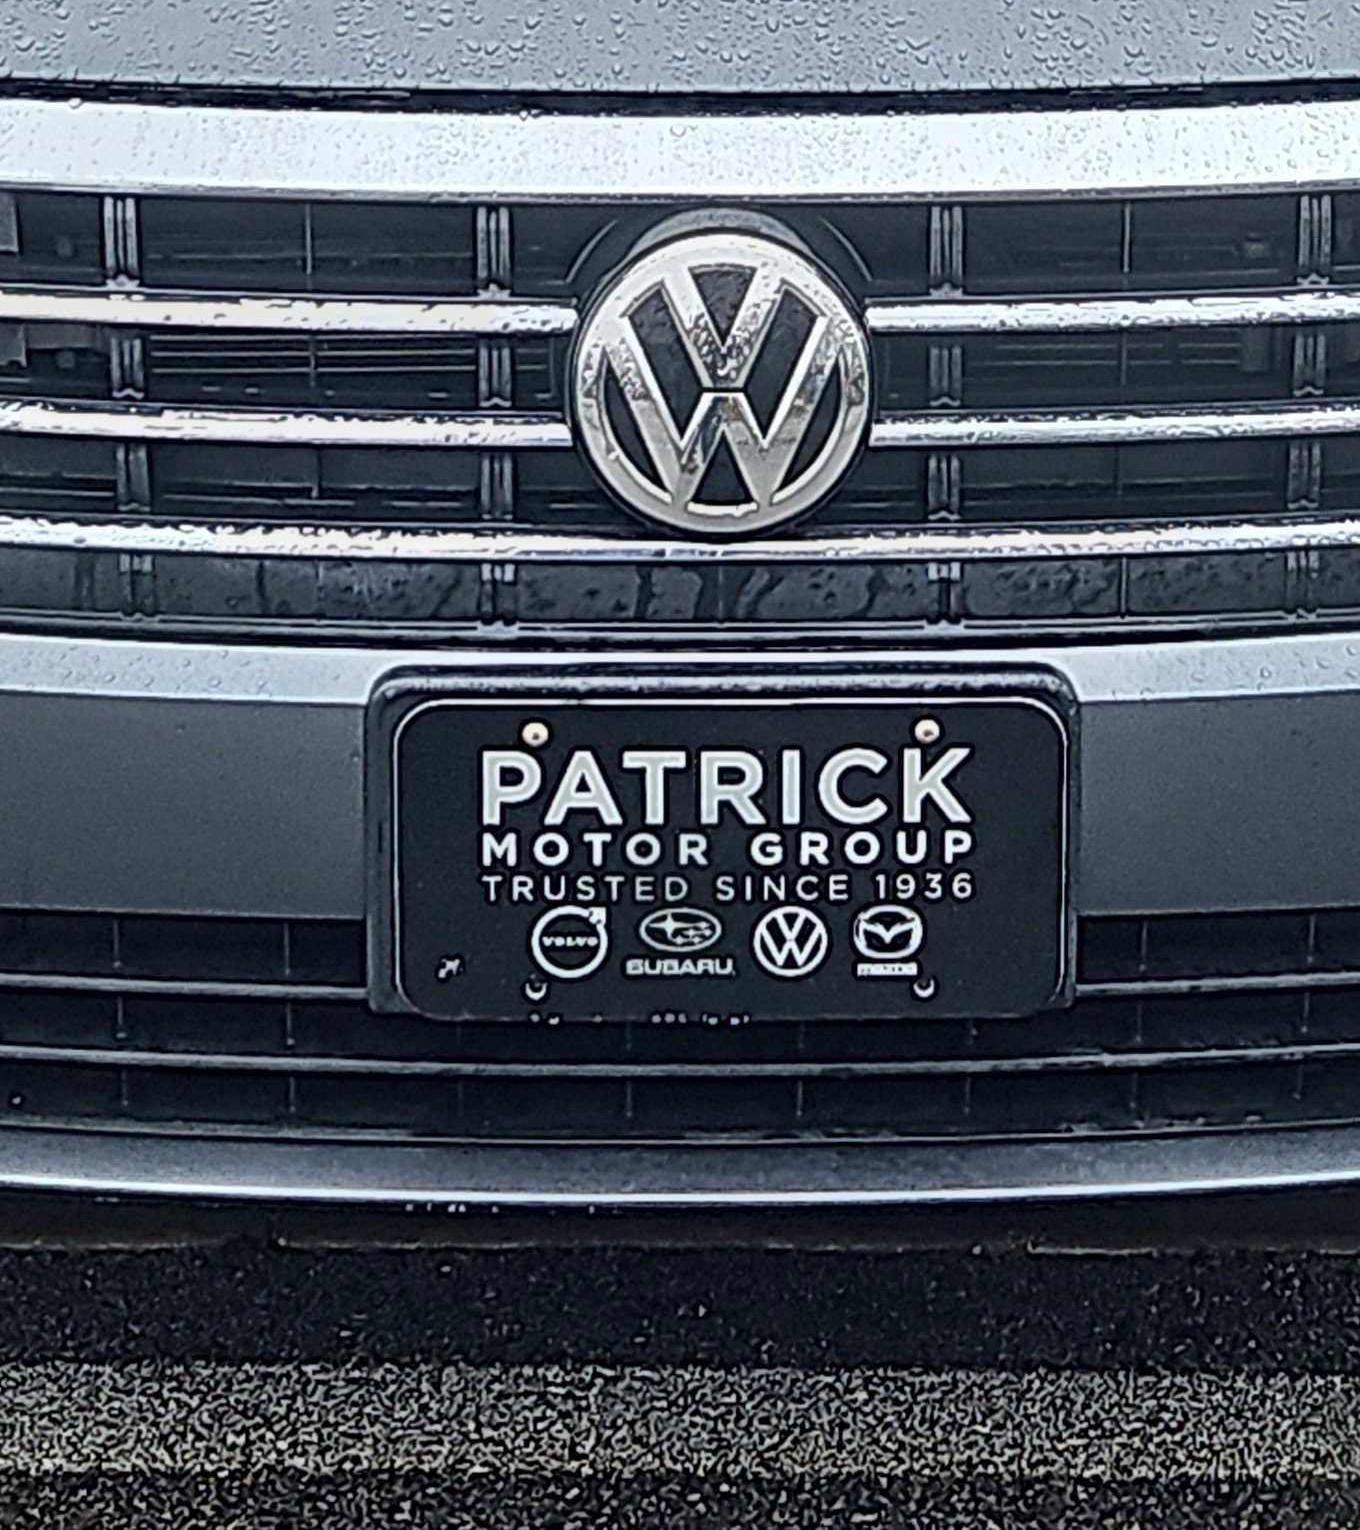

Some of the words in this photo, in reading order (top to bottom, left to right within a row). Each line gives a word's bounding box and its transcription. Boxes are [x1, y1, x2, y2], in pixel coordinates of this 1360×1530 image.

[482, 747, 972, 826] PATRICK
[482, 831, 709, 867] MOTOR
[750, 829, 973, 866] GROUP
[481, 875, 689, 902] TRUSTED
[716, 873, 849, 901] SINCE
[875, 872, 973, 900] 1936
[542, 936, 599, 947] VOLVO
[625, 958, 734, 976] SUBARU
